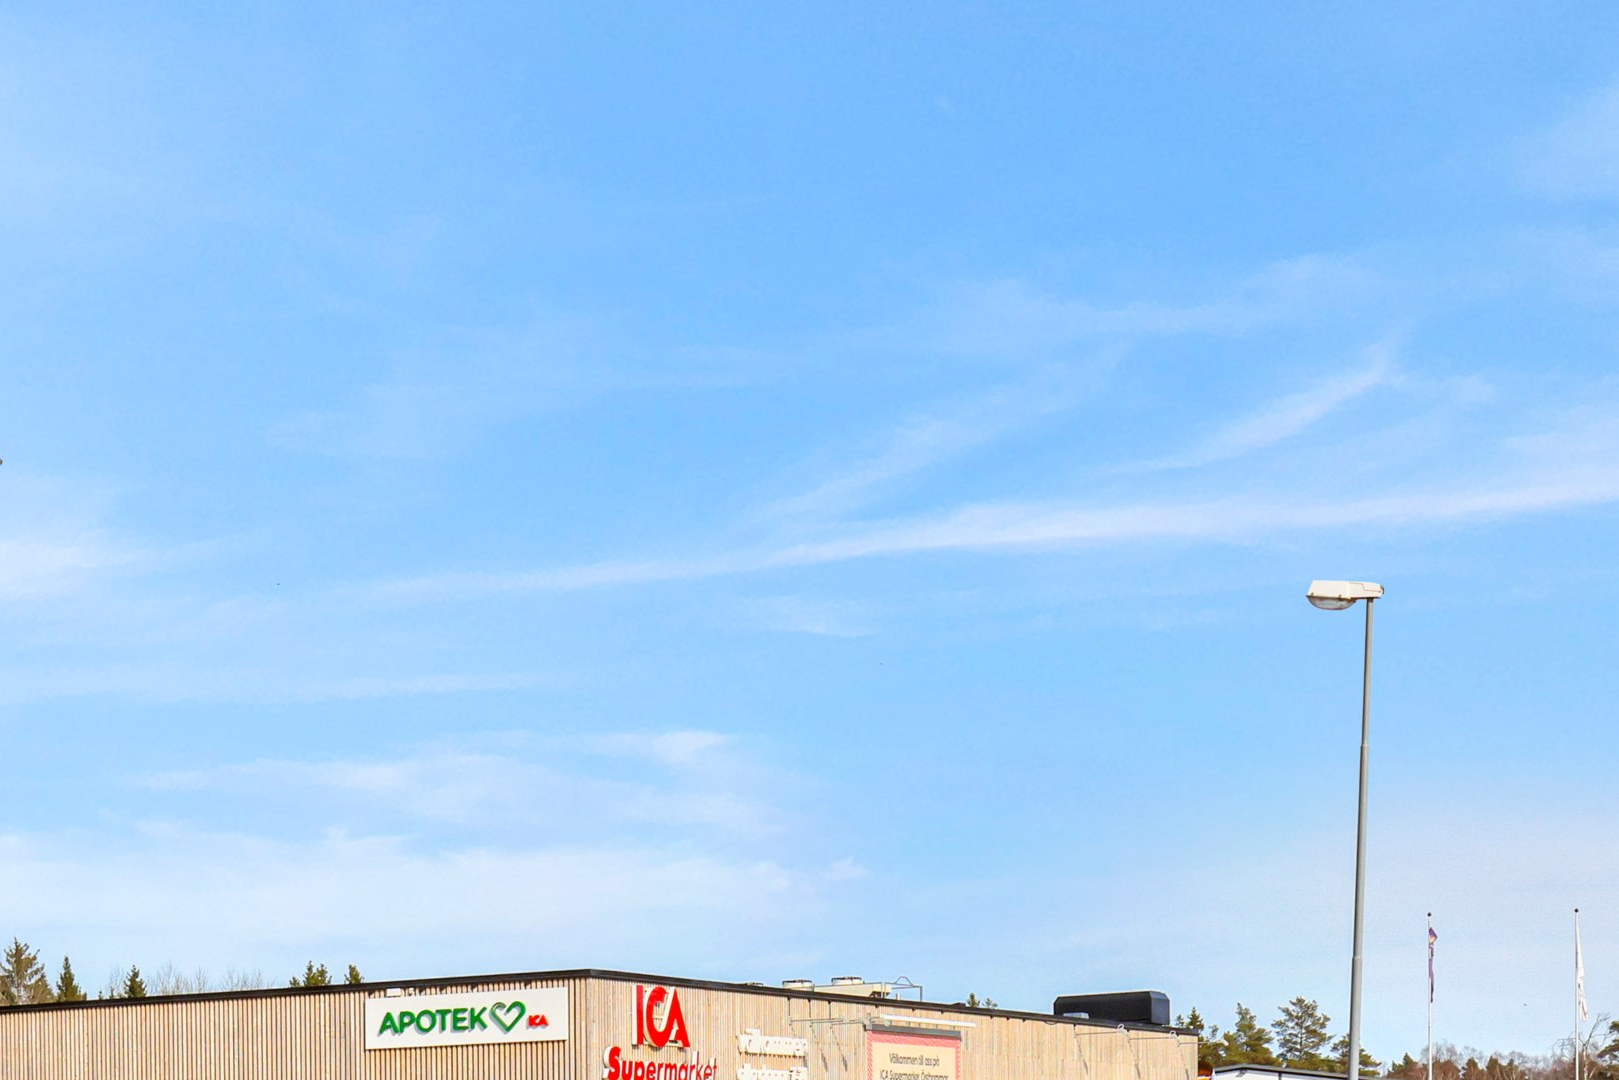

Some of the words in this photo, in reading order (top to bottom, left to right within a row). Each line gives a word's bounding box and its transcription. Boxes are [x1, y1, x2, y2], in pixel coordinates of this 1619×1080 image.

[378, 1007, 488, 1036] APOTEK
[527, 1014, 549, 1029] ICA
[632, 985, 690, 1047] ICA
